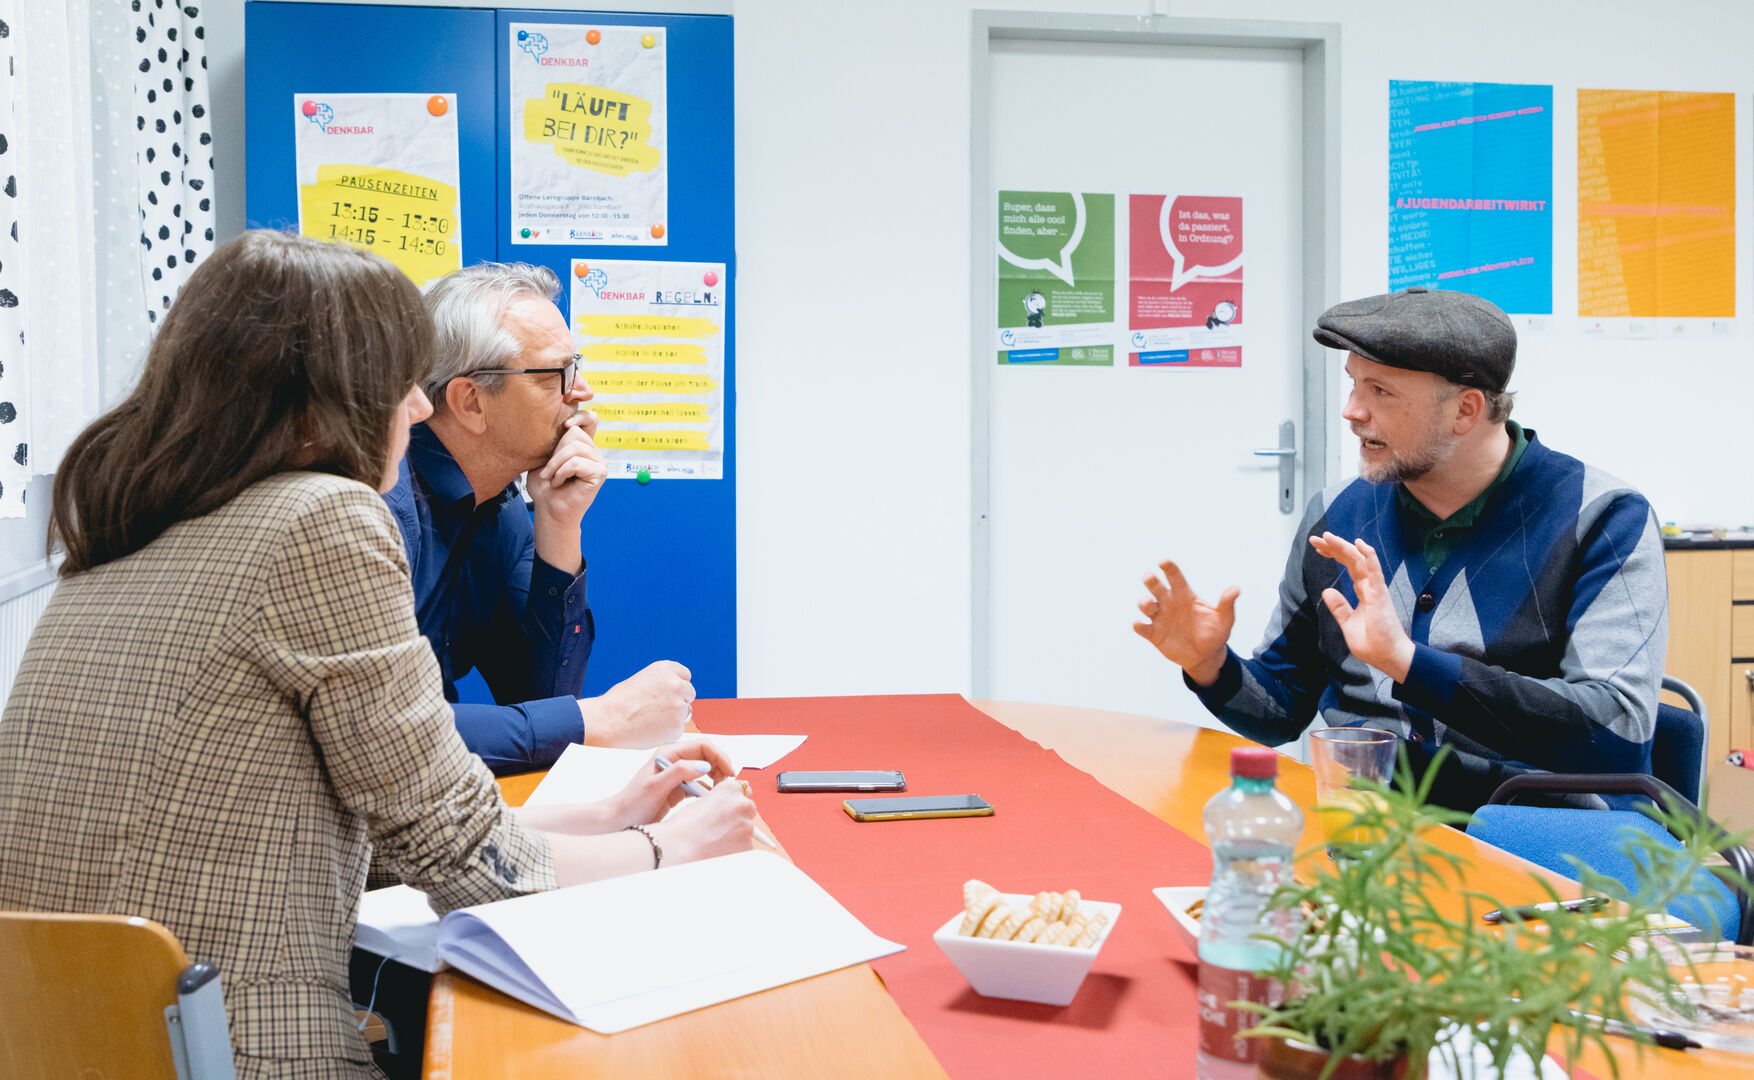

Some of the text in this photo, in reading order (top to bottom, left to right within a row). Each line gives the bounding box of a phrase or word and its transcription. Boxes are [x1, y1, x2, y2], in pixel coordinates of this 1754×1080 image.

[541, 57, 589, 67] DENKBAR
[552, 89, 631, 122] "LÄUFT
[327, 126, 374, 135] DENKBAR
[542, 117, 576, 141] BEI
[341, 175, 438, 199] PAUSENZEITEN
[542, 194, 580, 202] Lerngruppe
[1003, 202, 1056, 213] Super, dass
[1396, 197, 1546, 211] #JUGENDARBEITWIRKT
[331, 201, 379, 223] 13:15
[402, 213, 449, 234] 13:30
[538, 212, 577, 220] Donnerstag
[1003, 214, 1066, 224] mich alle cool
[1178, 210, 1230, 221] Ist das, was
[1003, 225, 1035, 236] finden,
[1036, 226, 1058, 236] aber
[1178, 222, 1230, 233] da passiert,
[327, 224, 376, 246] 14:15
[398, 235, 446, 256] 14:30
[1178, 234, 1234, 245] in Ordnung?
[600, 291, 717, 304] DENKBAR REGELN:
